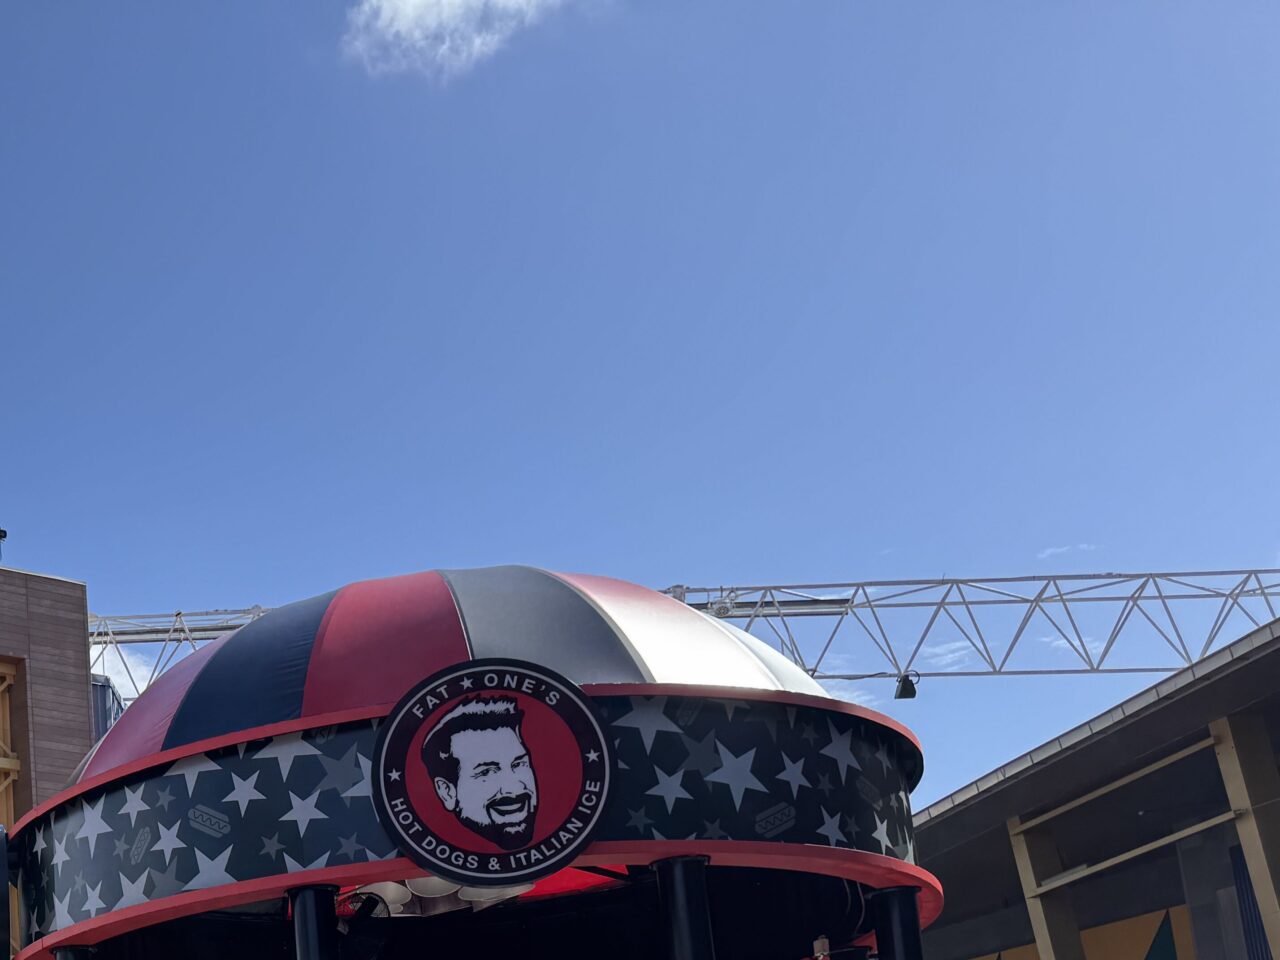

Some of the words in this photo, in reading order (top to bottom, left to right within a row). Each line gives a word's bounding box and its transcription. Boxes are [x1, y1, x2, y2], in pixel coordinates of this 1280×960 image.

[411, 684, 450, 719] FAT
[483, 673, 561, 707] ONE'S
[391, 797, 423, 836] HOT
[421, 835, 480, 870] DOGS
[487, 857, 502, 871] &
[510, 817, 584, 869] ITALIAN
[579, 780, 601, 815] ICE
